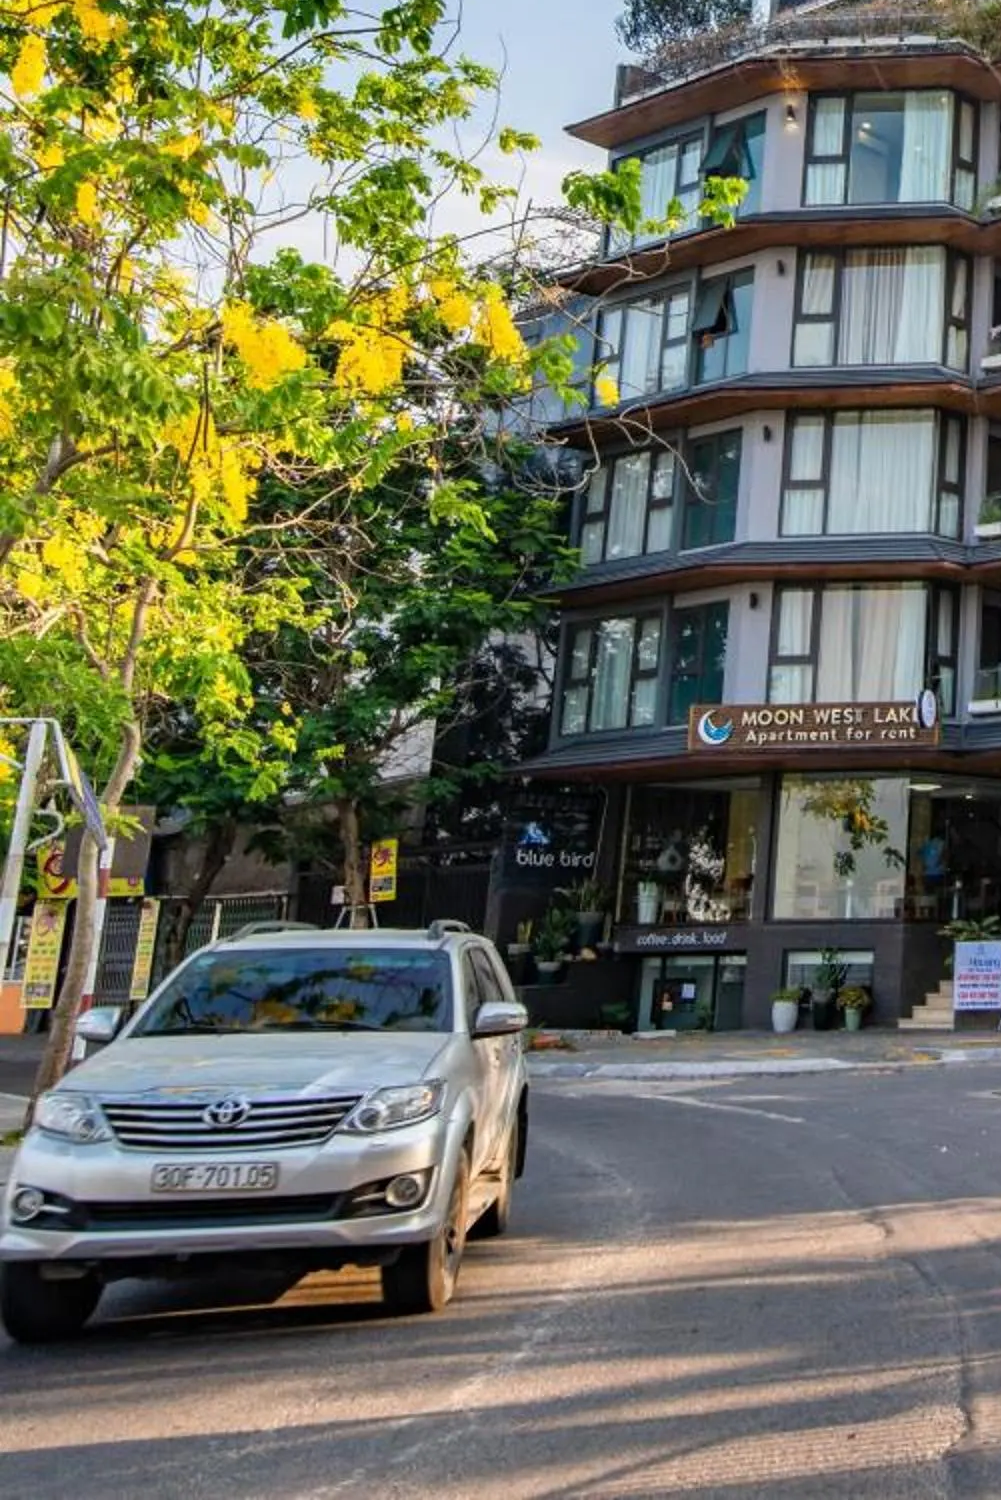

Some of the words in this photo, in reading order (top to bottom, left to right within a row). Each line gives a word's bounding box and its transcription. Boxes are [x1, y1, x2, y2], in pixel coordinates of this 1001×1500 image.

[741, 708, 803, 726] MOON
[813, 707, 863, 725] WEST
[746, 729, 837, 745] Apartment
[846, 726, 872, 740] for
[880, 726, 916, 740] rent
[516, 848, 555, 867] blue
[560, 850, 594, 868] bird
